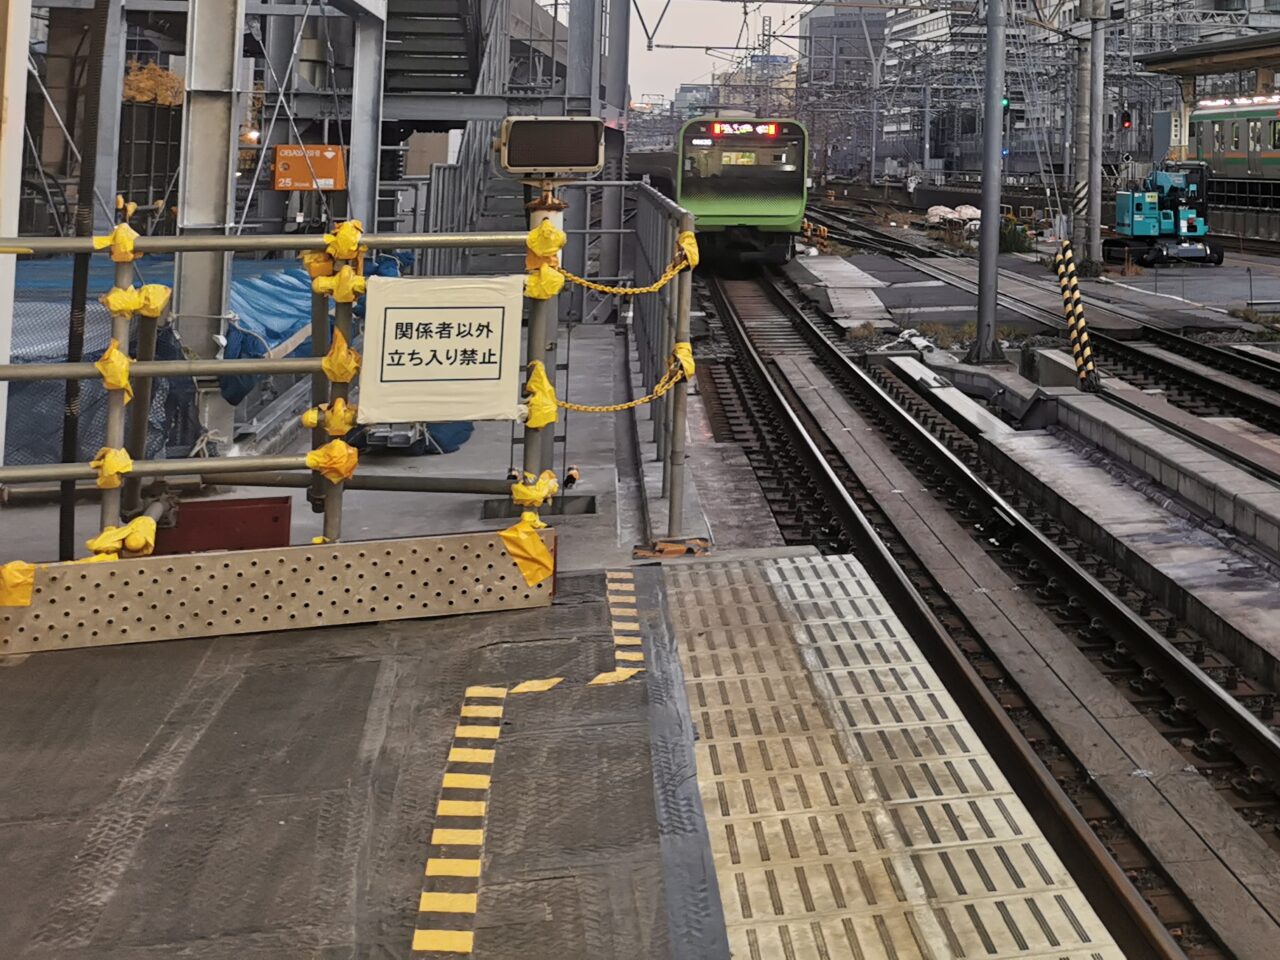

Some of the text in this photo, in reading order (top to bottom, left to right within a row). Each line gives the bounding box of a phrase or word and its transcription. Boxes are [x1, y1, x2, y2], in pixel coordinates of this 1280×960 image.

[278, 178, 293, 187] 25
[394, 321, 494, 340] 関係者以外
[386, 348, 498, 367] 立ち入り禁止
